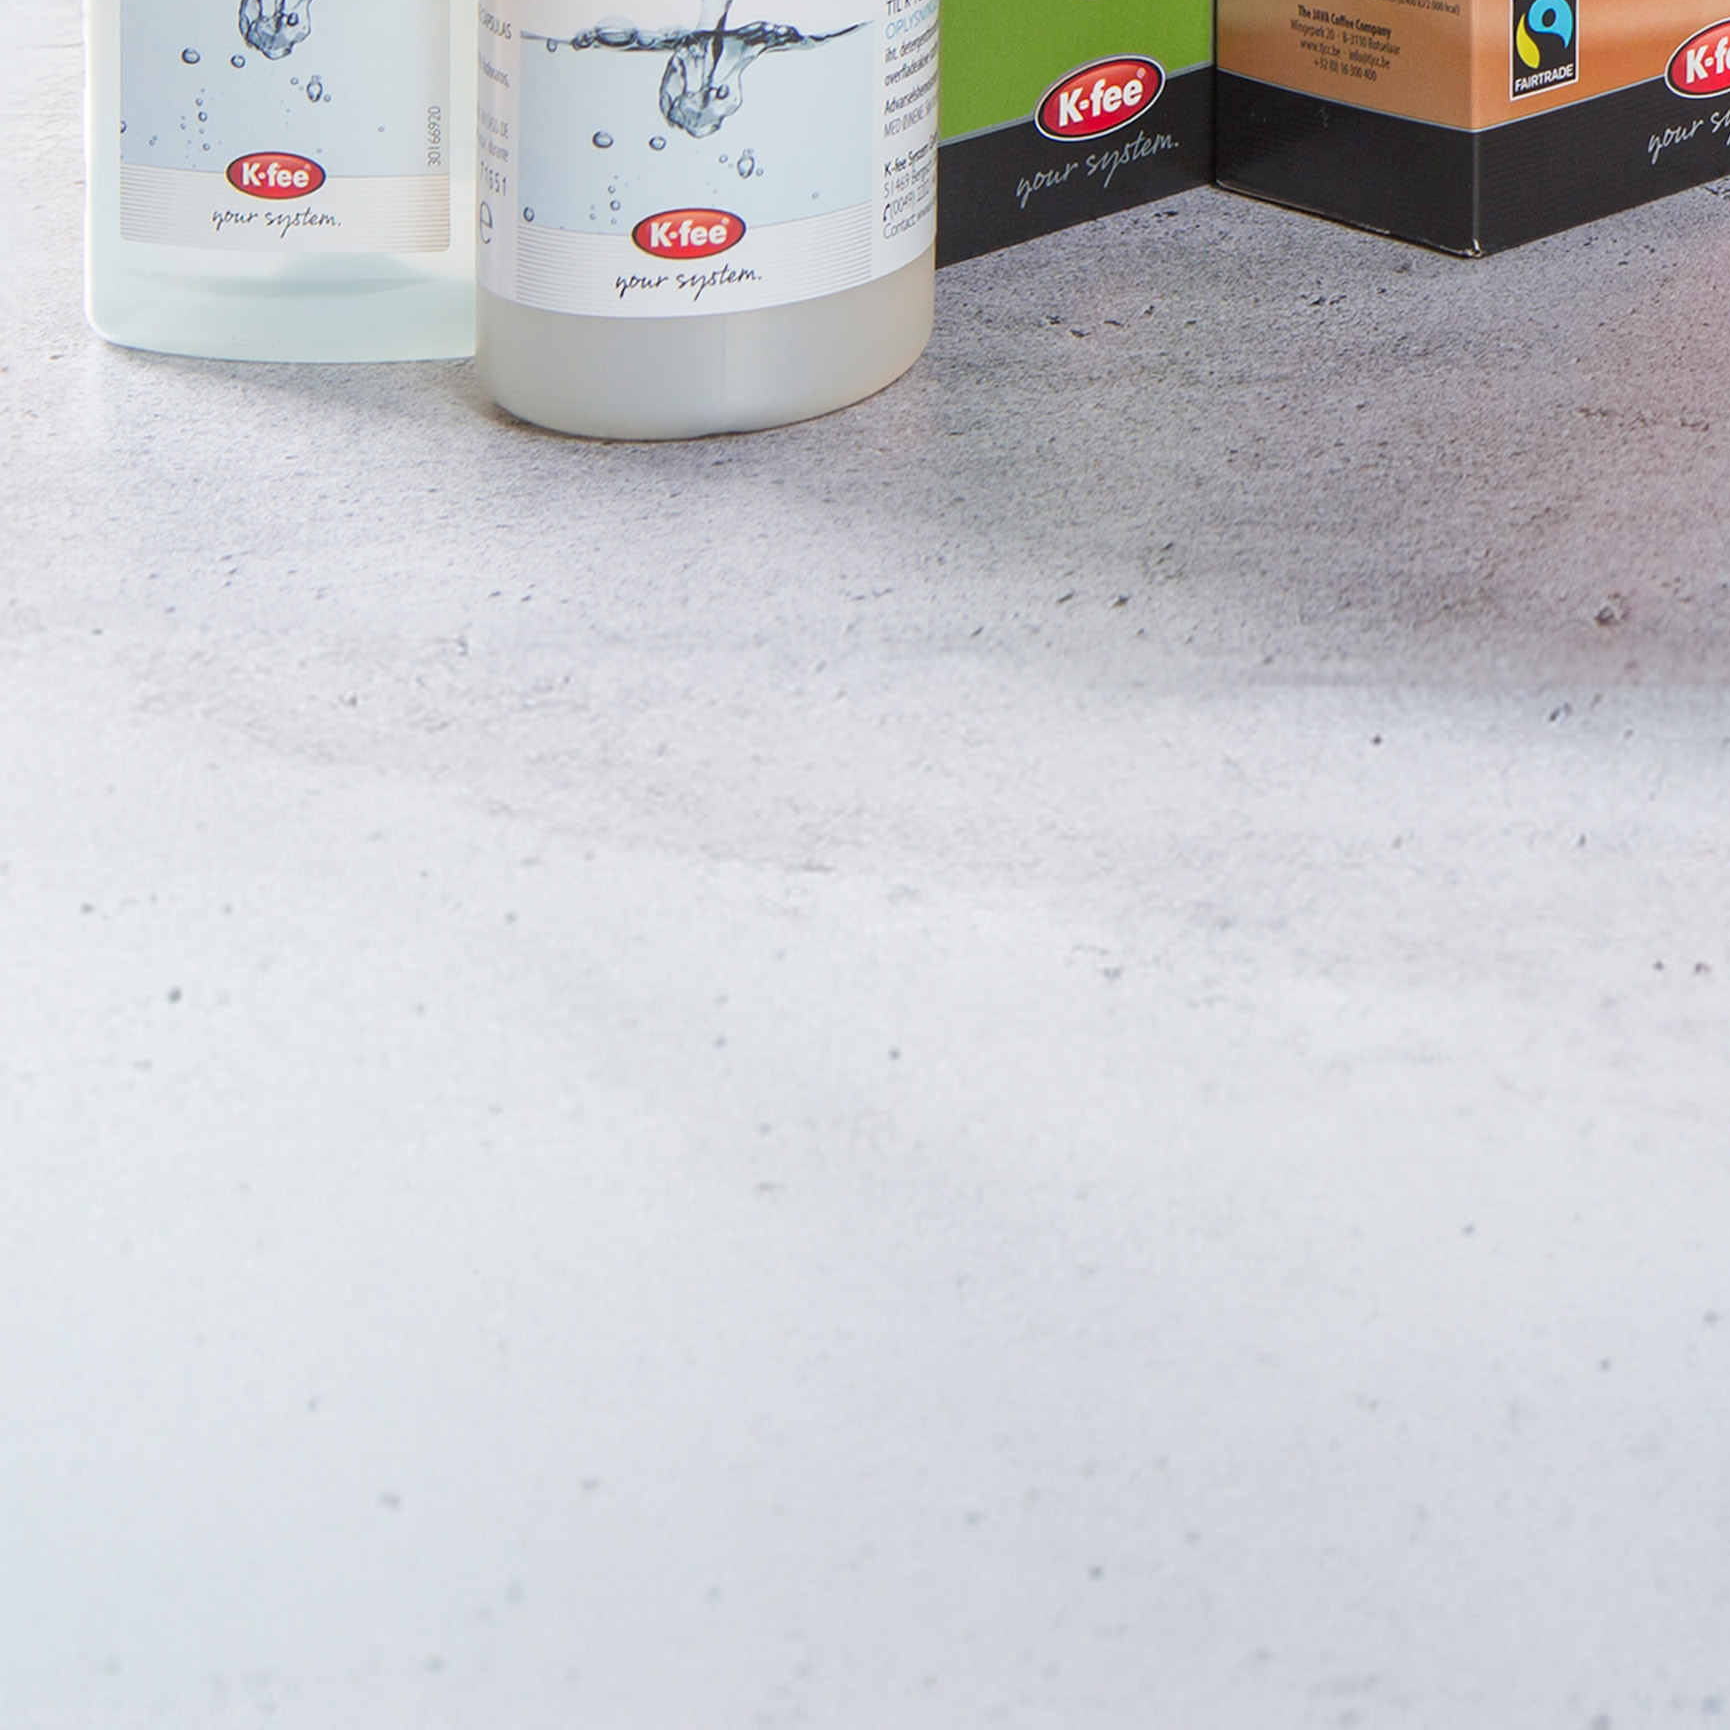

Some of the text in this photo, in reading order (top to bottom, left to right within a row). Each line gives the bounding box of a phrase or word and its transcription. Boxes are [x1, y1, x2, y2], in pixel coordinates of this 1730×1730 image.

[1515, 63, 1573, 93] FAIRTRADE
[428, 106, 441, 166] 30166920
[1648, 120, 1703, 164] your
[1016, 163, 1078, 208] your
[212, 211, 258, 231] your
[616, 276, 668, 298] your
